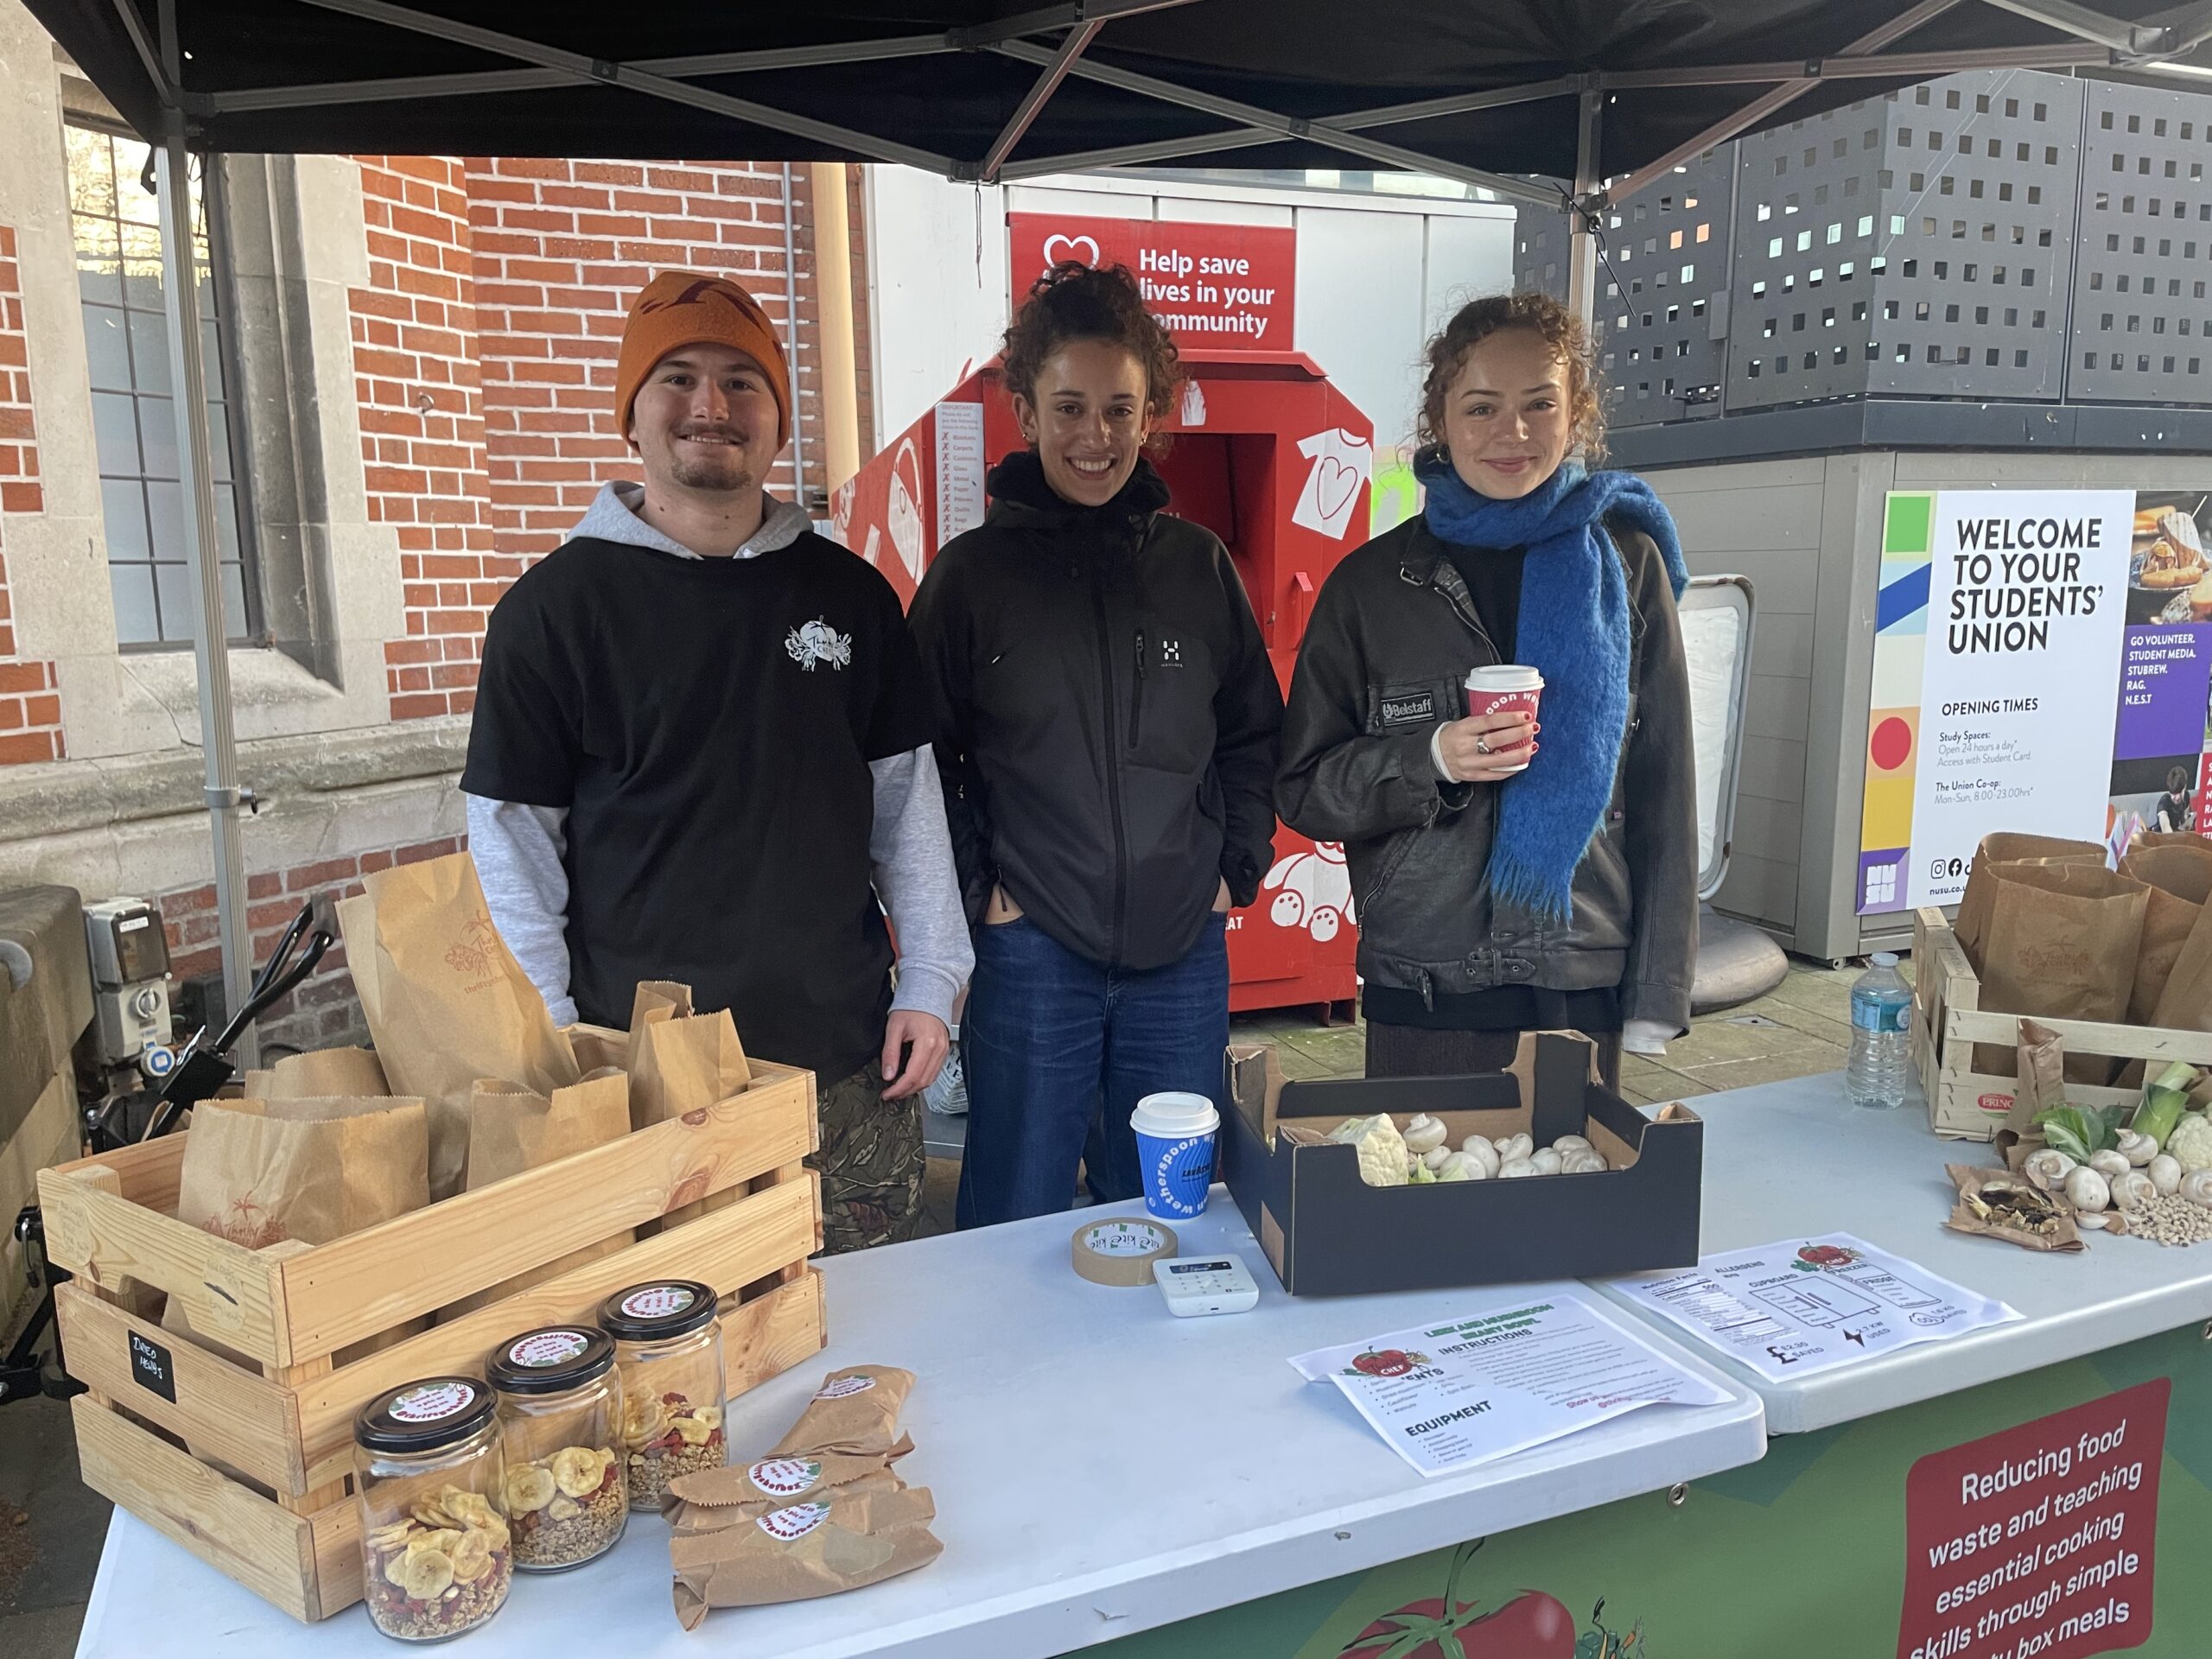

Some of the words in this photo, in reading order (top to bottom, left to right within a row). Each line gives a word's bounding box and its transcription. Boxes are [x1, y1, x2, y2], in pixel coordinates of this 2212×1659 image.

[1140, 249, 1193, 278] Help
[1199, 257, 1249, 276] save
[1140, 277, 1190, 302] lives
[1197, 281, 1217, 302] in
[1224, 287, 1275, 309] your
[1151, 311, 1268, 339] ommunity
[1957, 518, 2102, 550] WELCOME
[1954, 554, 1992, 585] TO
[2000, 553, 2081, 583] YOUR
[1948, 620, 2048, 654] UNION
[2131, 636, 2144, 646] GO
[2145, 633, 2196, 645] VOLUNTEER.
[2129, 649, 2167, 661] STUDENT
[2168, 648, 2196, 658] MEDIA.
[2127, 664, 2168, 676] STUBREW.
[2126, 680, 2146, 690] RAG.
[1393, 699, 1433, 717] Belstaff
[1942, 701, 1999, 715] OPENING
[2004, 698, 2038, 712] TIMES
[2126, 694, 2152, 705] N.E.S.T
[1940, 731, 1961, 744] Study
[1963, 730, 1991, 743] Spaces:
[1938, 744, 1960, 757] Open
[1961, 743, 1972, 753] 24
[1974, 743, 1994, 753] hours
[1936, 758, 1964, 767] Access
[1966, 756, 1980, 765] with
[1982, 753, 2012, 764] Student
[1936, 782, 1949, 791] The
[1952, 780, 1974, 791] Union
[1976, 779, 2001, 791] Co-op:
[1929, 886, 1966, 895] nusu.co.u
[1158, 1136, 1198, 1214] wetherspoon
[1715, 1261, 1765, 1274] ALLERGENS
[1642, 1276, 1675, 1290] Nutrition
[1749, 1274, 1798, 1287] CUPBOARD
[1438, 1329, 1533, 1355] INSTRUCTIONS
[1867, 1329, 1891, 1339] USED
[133, 1337, 156, 1359] DRIED
[1792, 1348, 1825, 1359] SAVED
[1380, 1364, 1404, 1375] CHEF
[1405, 1400, 1491, 1436] EQUIPMENT
[1962, 1446, 2071, 1504] Reducing
[2077, 1419, 2126, 1462] food
[1929, 1522, 2002, 1568] waste
[2007, 1496, 2049, 1538] and
[2054, 1462, 2142, 1516] teaching
[1936, 1544, 2041, 1614] essential
[2044, 1511, 2125, 1567] cooking
[1910, 1625, 1972, 1659] skills
[1977, 1580, 2062, 1639] through
[2065, 1549, 2139, 1597] simple
[2019, 1627, 2055, 1659] box
[2059, 1598, 2130, 1642] meals
